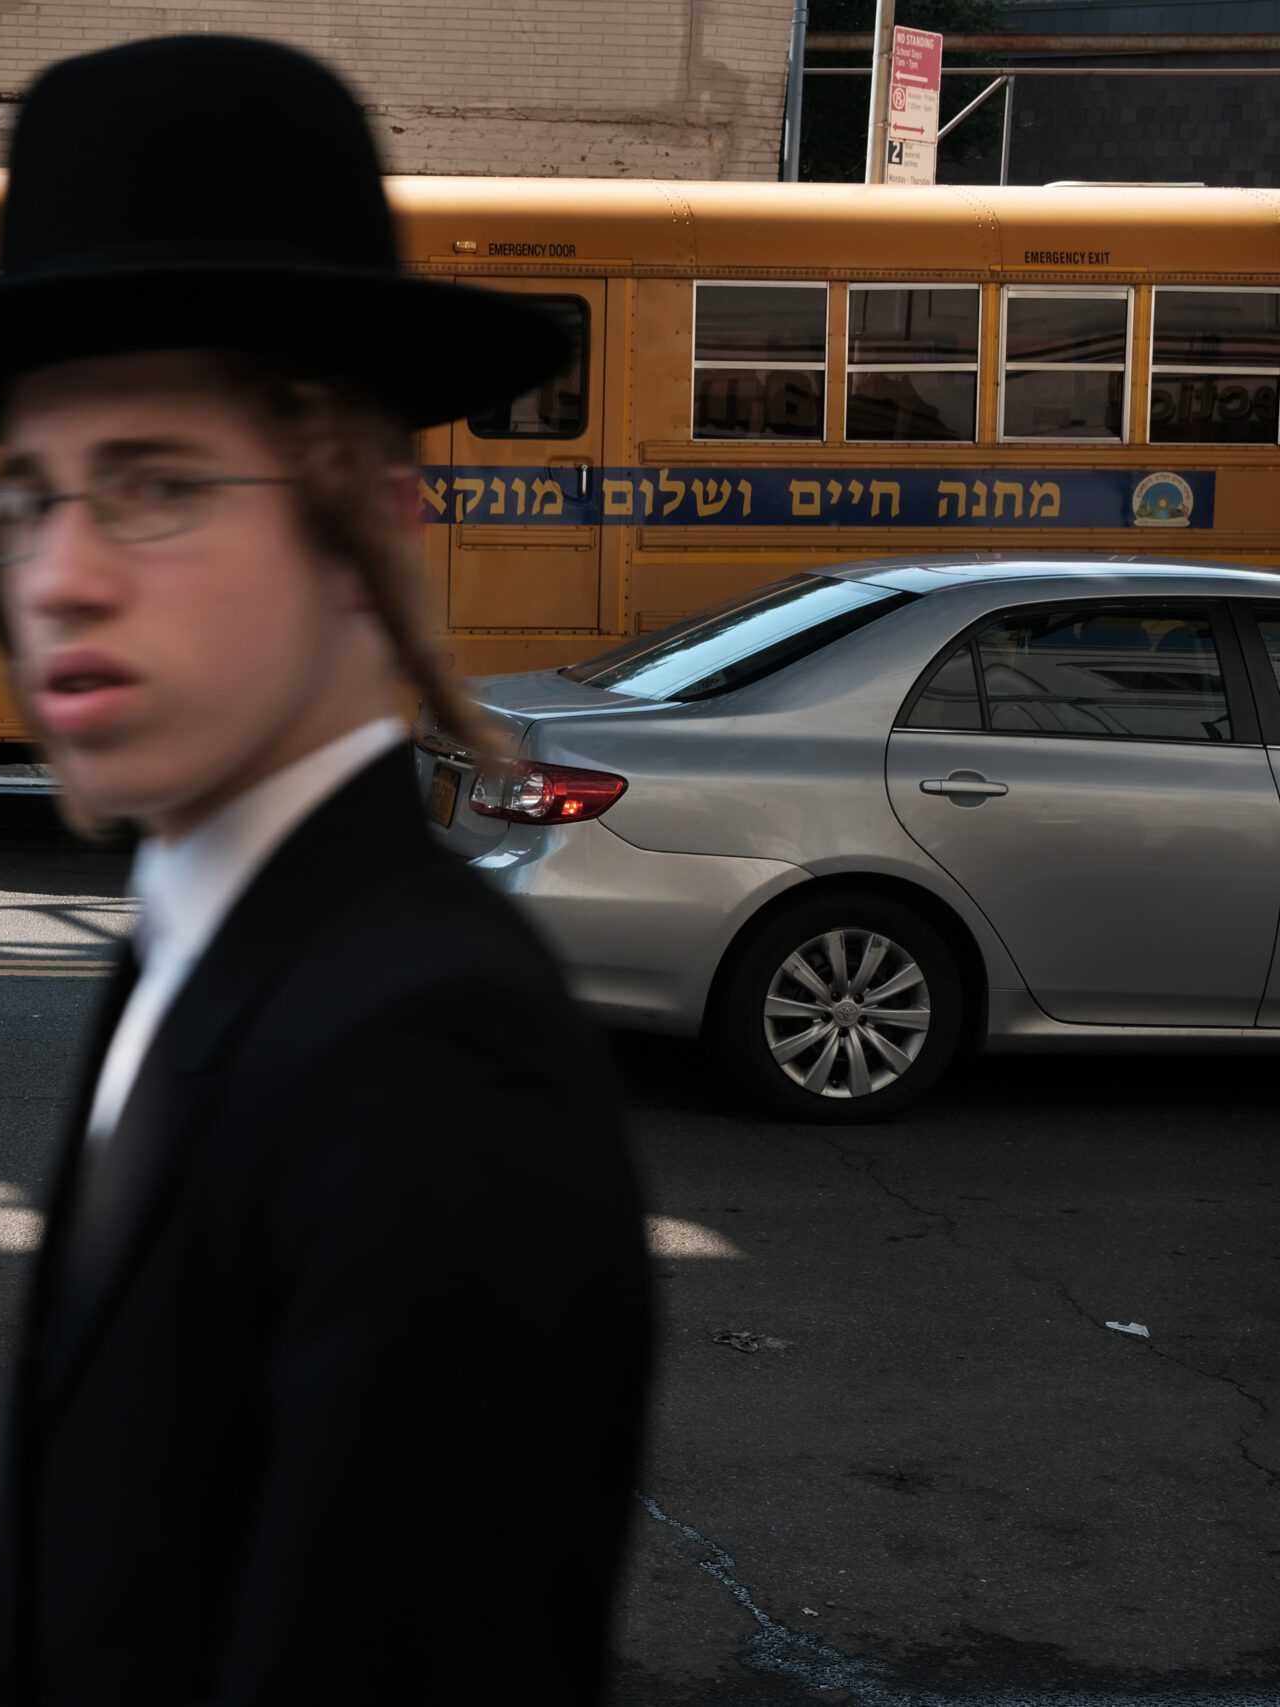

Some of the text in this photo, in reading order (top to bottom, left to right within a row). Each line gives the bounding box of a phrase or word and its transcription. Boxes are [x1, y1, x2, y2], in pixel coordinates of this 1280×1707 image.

[896, 33, 934, 50] NO STANDING
[896, 47, 923, 60] School Days
[891, 141, 900, 163] 2
[889, 173, 905, 184] Monday
[489, 243, 577, 257] EMERGENCY DOOR
[1024, 251, 1110, 265] EMERGENCY EXIT
[602, 468, 752, 517] ושלום
[789, 479, 901, 518] חיים
[937, 479, 1061, 518] מחנה
